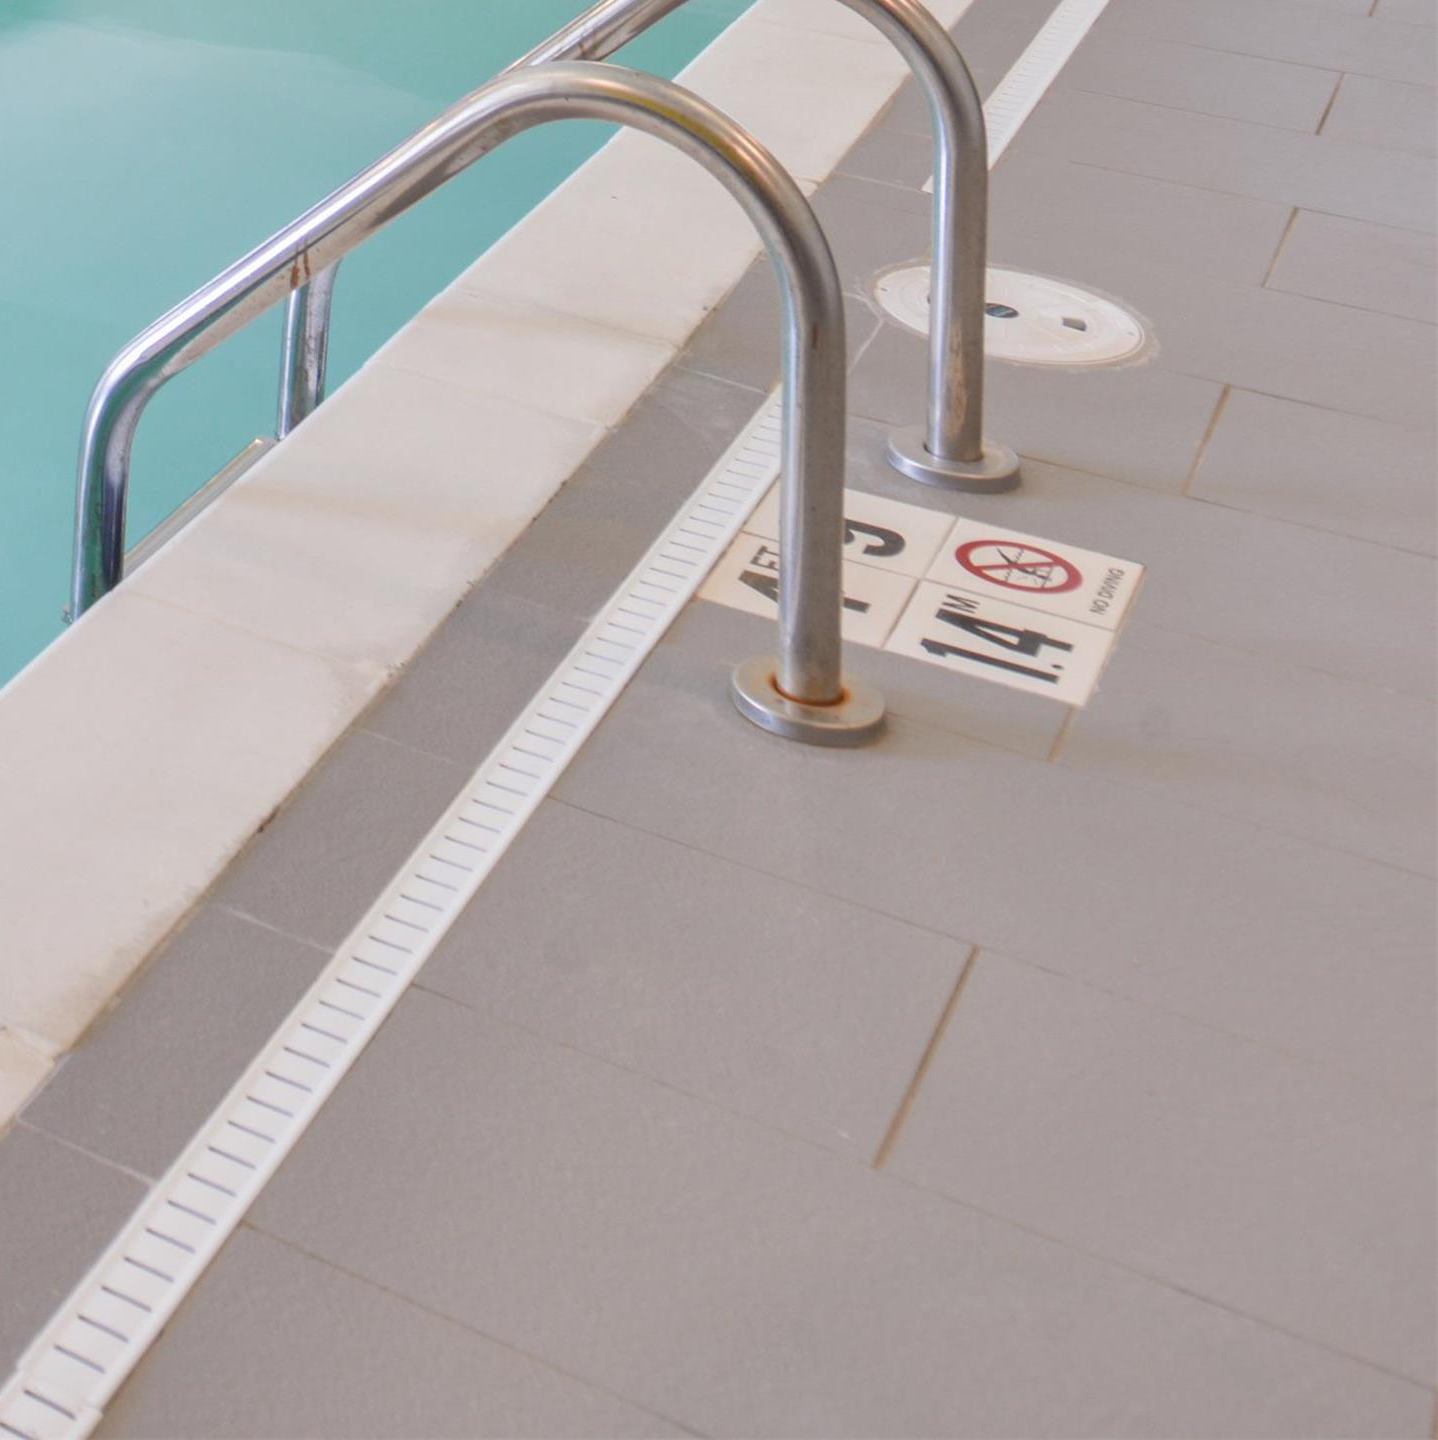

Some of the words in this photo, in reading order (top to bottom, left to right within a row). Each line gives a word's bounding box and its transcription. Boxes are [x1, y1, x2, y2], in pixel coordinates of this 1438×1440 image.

[1097, 567, 1125, 600] DIVING
[941, 594, 981, 615] M
[1089, 599, 1110, 616] NO
